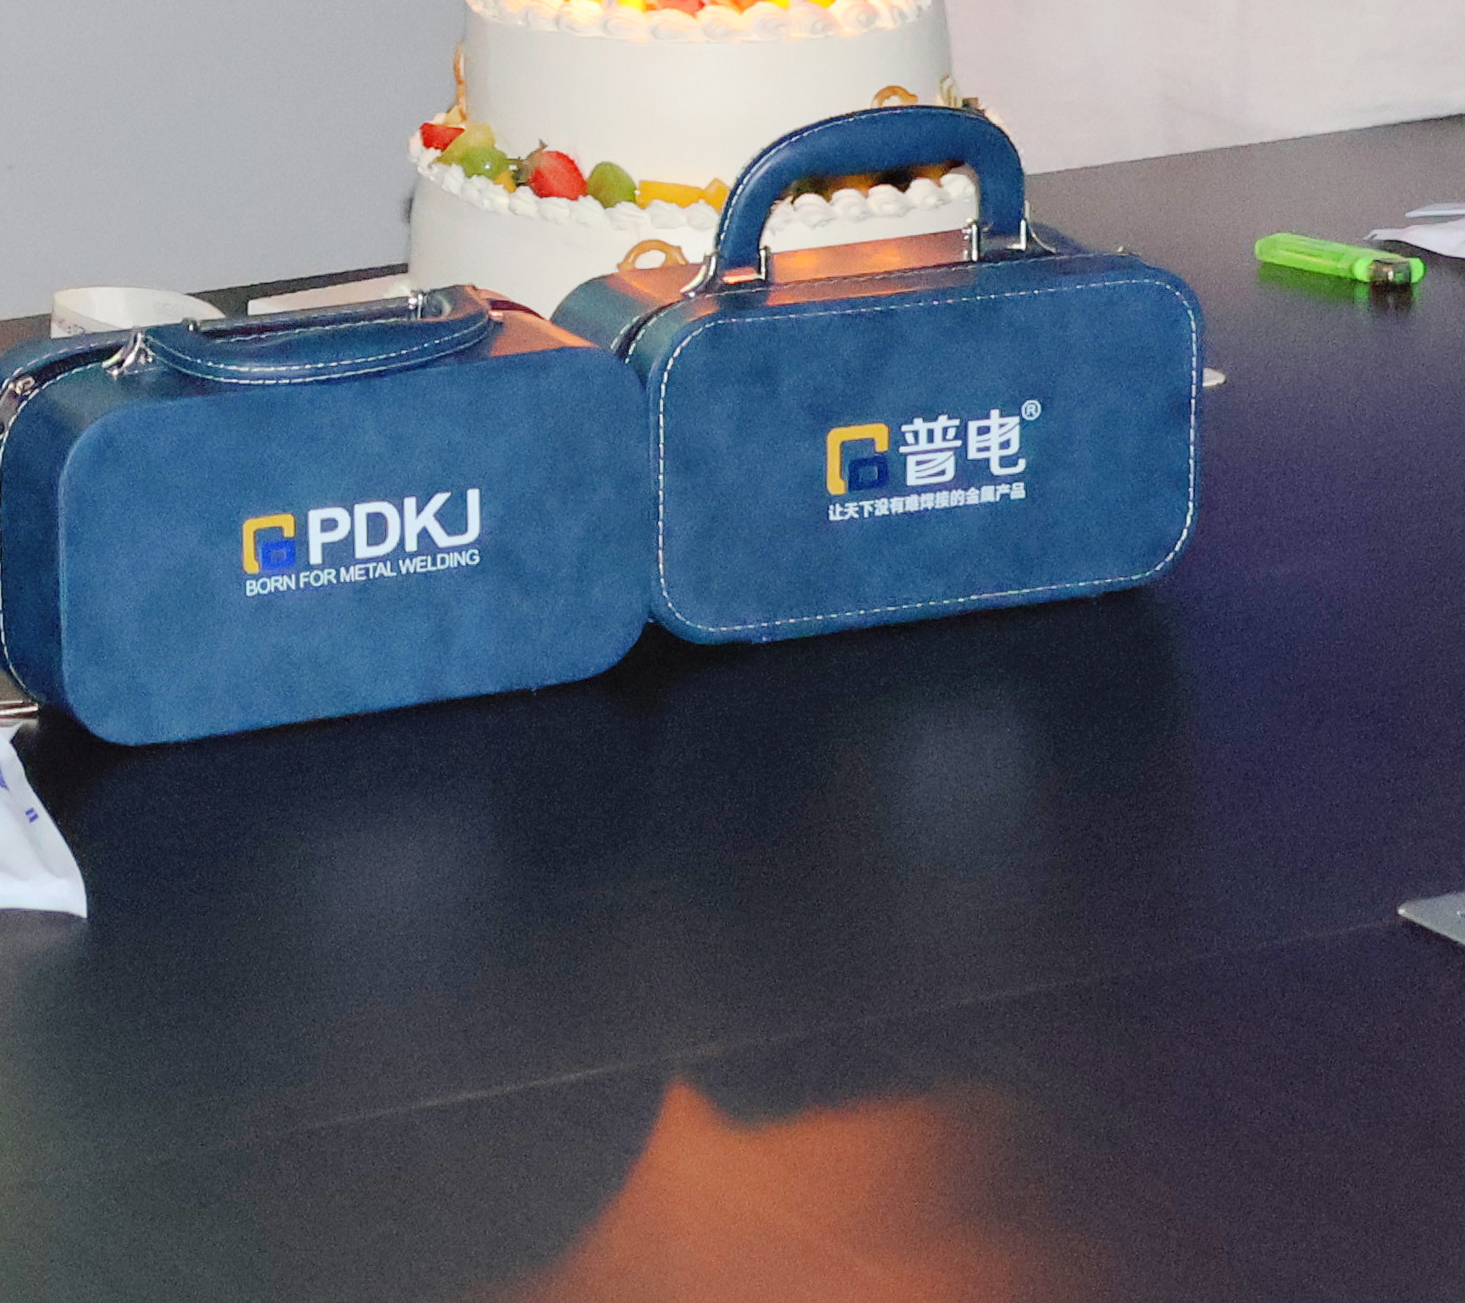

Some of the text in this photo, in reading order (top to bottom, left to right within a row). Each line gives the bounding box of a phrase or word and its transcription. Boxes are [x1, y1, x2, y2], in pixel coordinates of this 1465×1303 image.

[898, 408, 1027, 486] 普电
[307, 488, 481, 565] PDKJ
[245, 548, 481, 597] BORN FOR METAL WELDING
